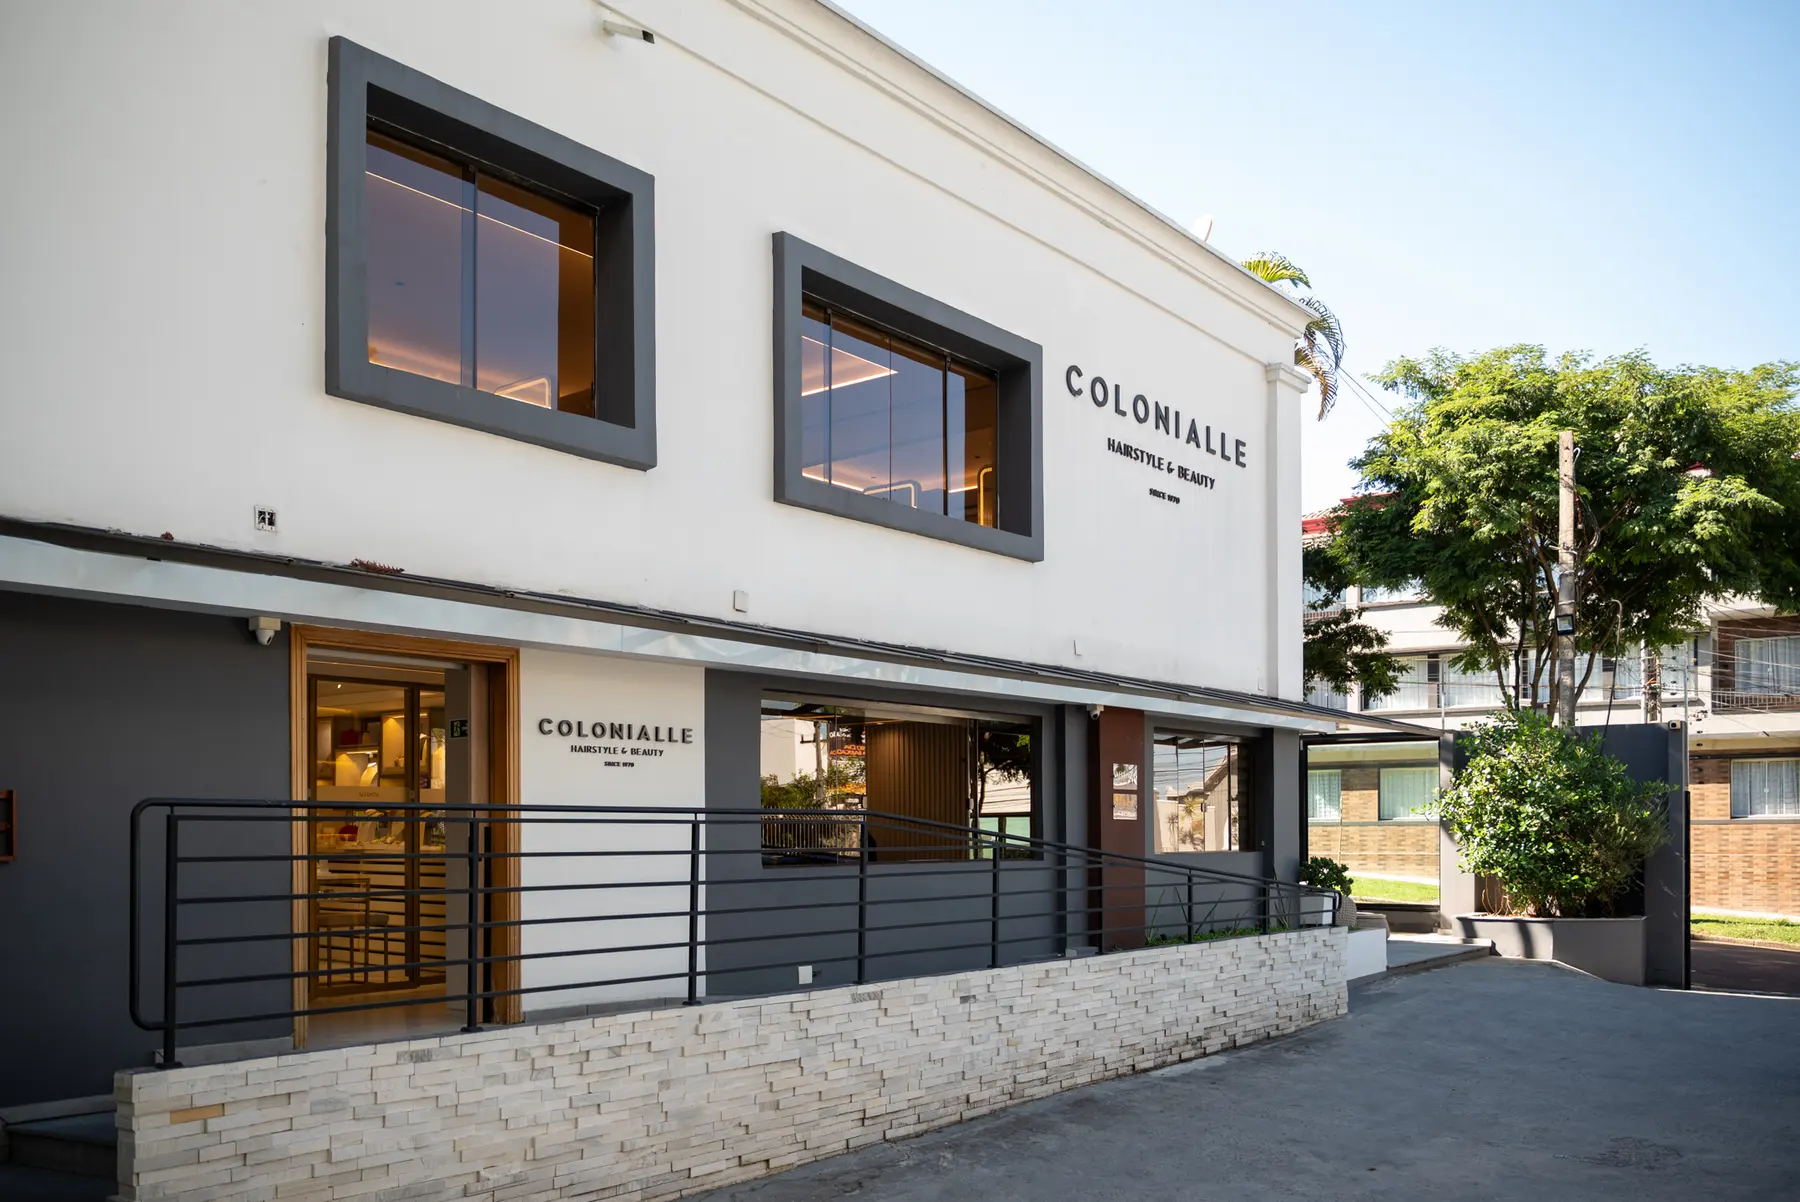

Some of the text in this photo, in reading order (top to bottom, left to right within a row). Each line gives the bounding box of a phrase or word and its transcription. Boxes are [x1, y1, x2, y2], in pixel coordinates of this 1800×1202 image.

[1065, 364, 1247, 468] COLONIALLE
[1107, 437, 1216, 490] HAIRSTYLE & BEAUTY
[1149, 487, 1167, 500] SINCE
[537, 717, 694, 745] COLONIALLE
[570, 744, 664, 757] HAIRSTYLE & BEAUTY
